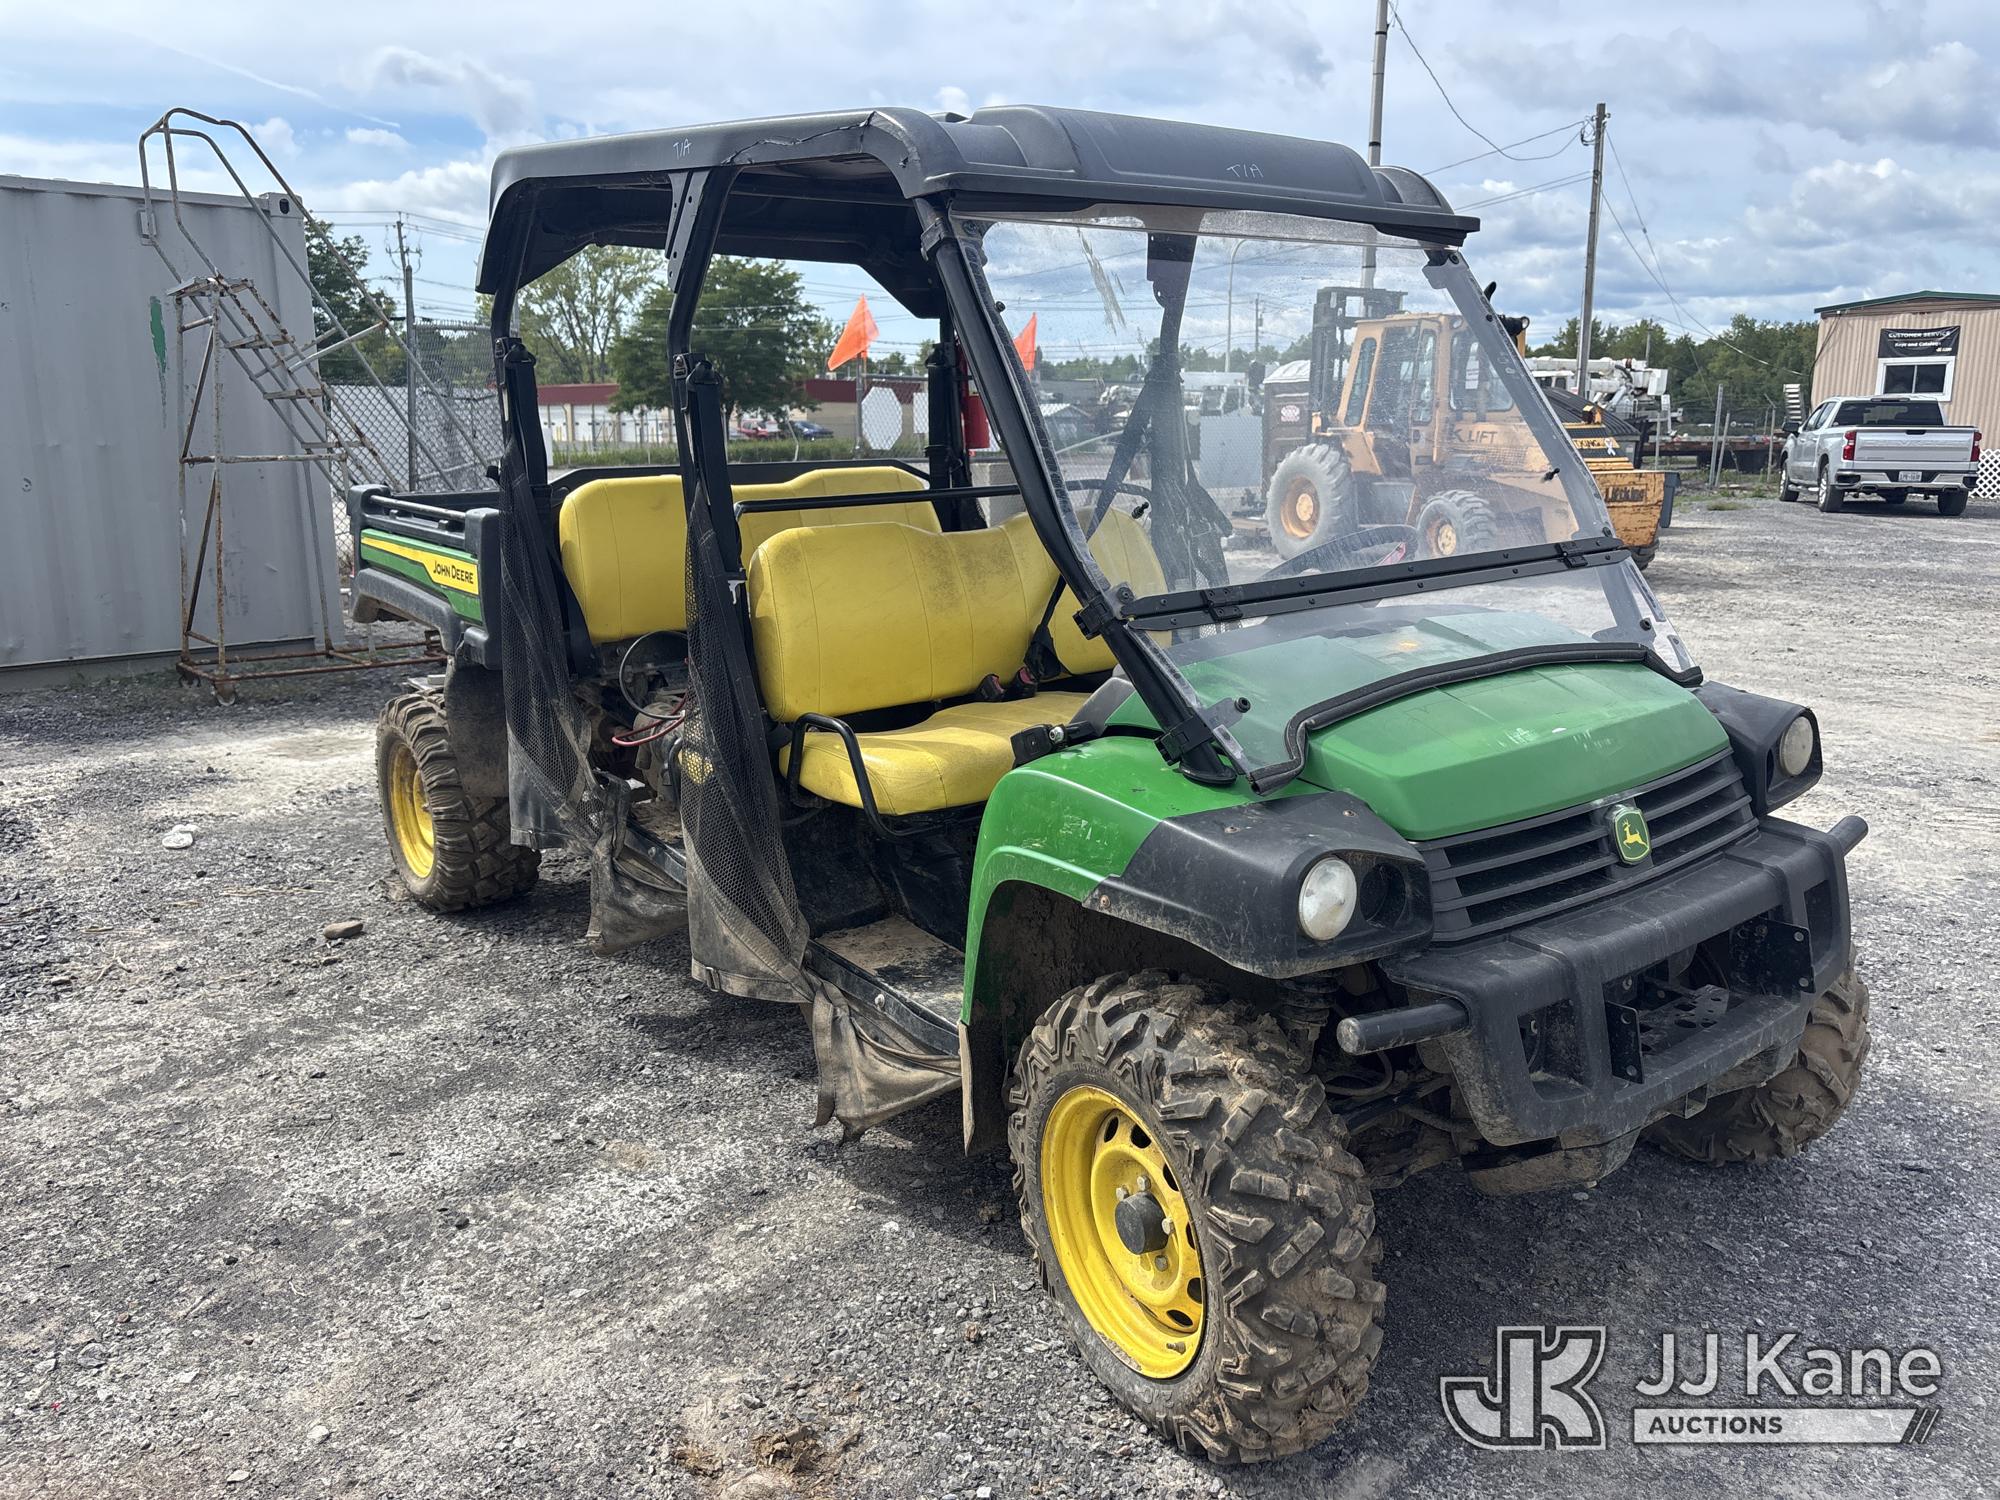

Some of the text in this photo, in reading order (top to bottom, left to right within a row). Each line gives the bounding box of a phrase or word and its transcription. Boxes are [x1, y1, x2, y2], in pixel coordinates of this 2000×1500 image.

[1468, 430, 1498, 443] LIFT
[433, 560, 474, 585] JOHN DEERE
